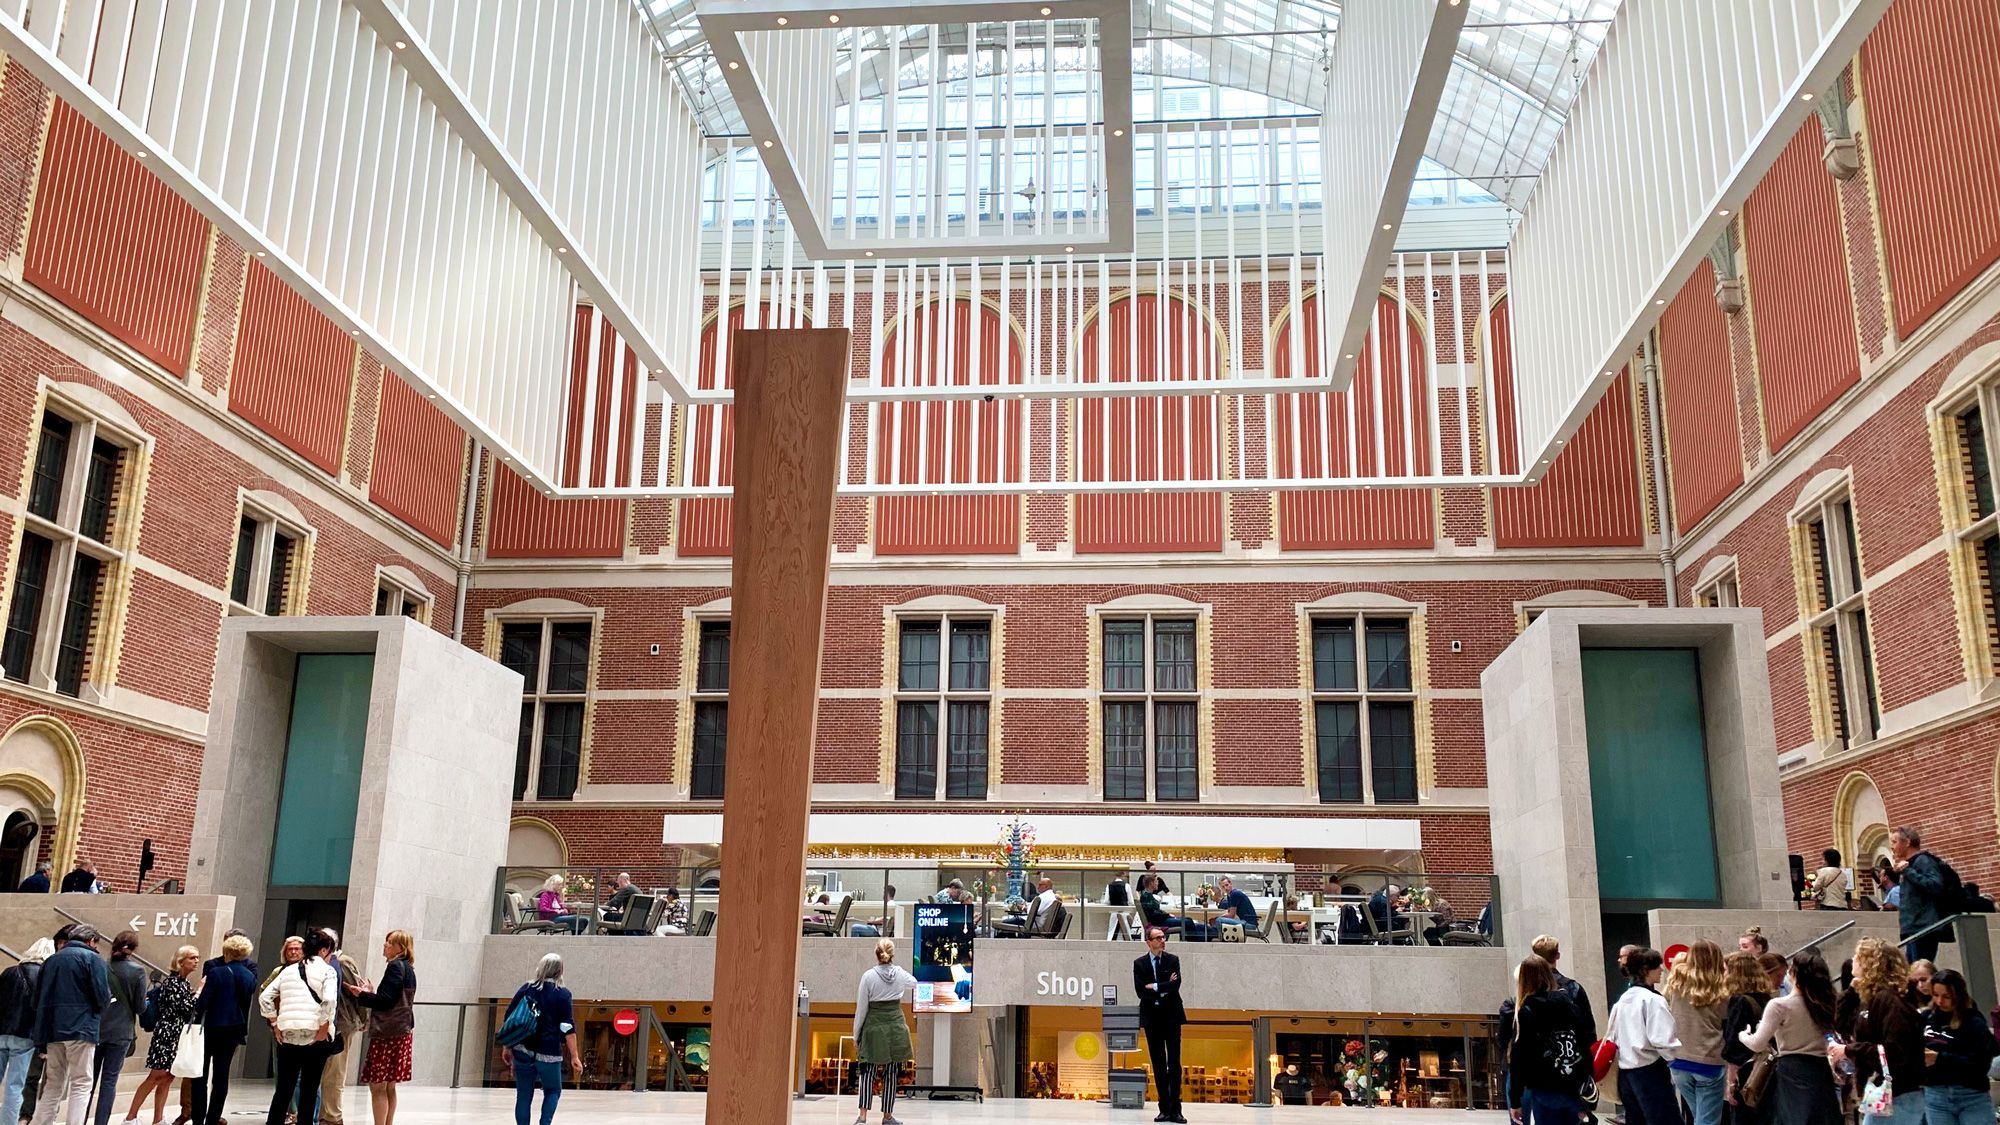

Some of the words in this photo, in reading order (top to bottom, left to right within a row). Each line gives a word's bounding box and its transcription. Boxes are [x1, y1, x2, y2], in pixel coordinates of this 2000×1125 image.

[918, 908, 941, 917] SHOP
[153, 912, 199, 937] Exit
[918, 918, 949, 927] ONLINE
[1037, 971, 1095, 1001] Shop
